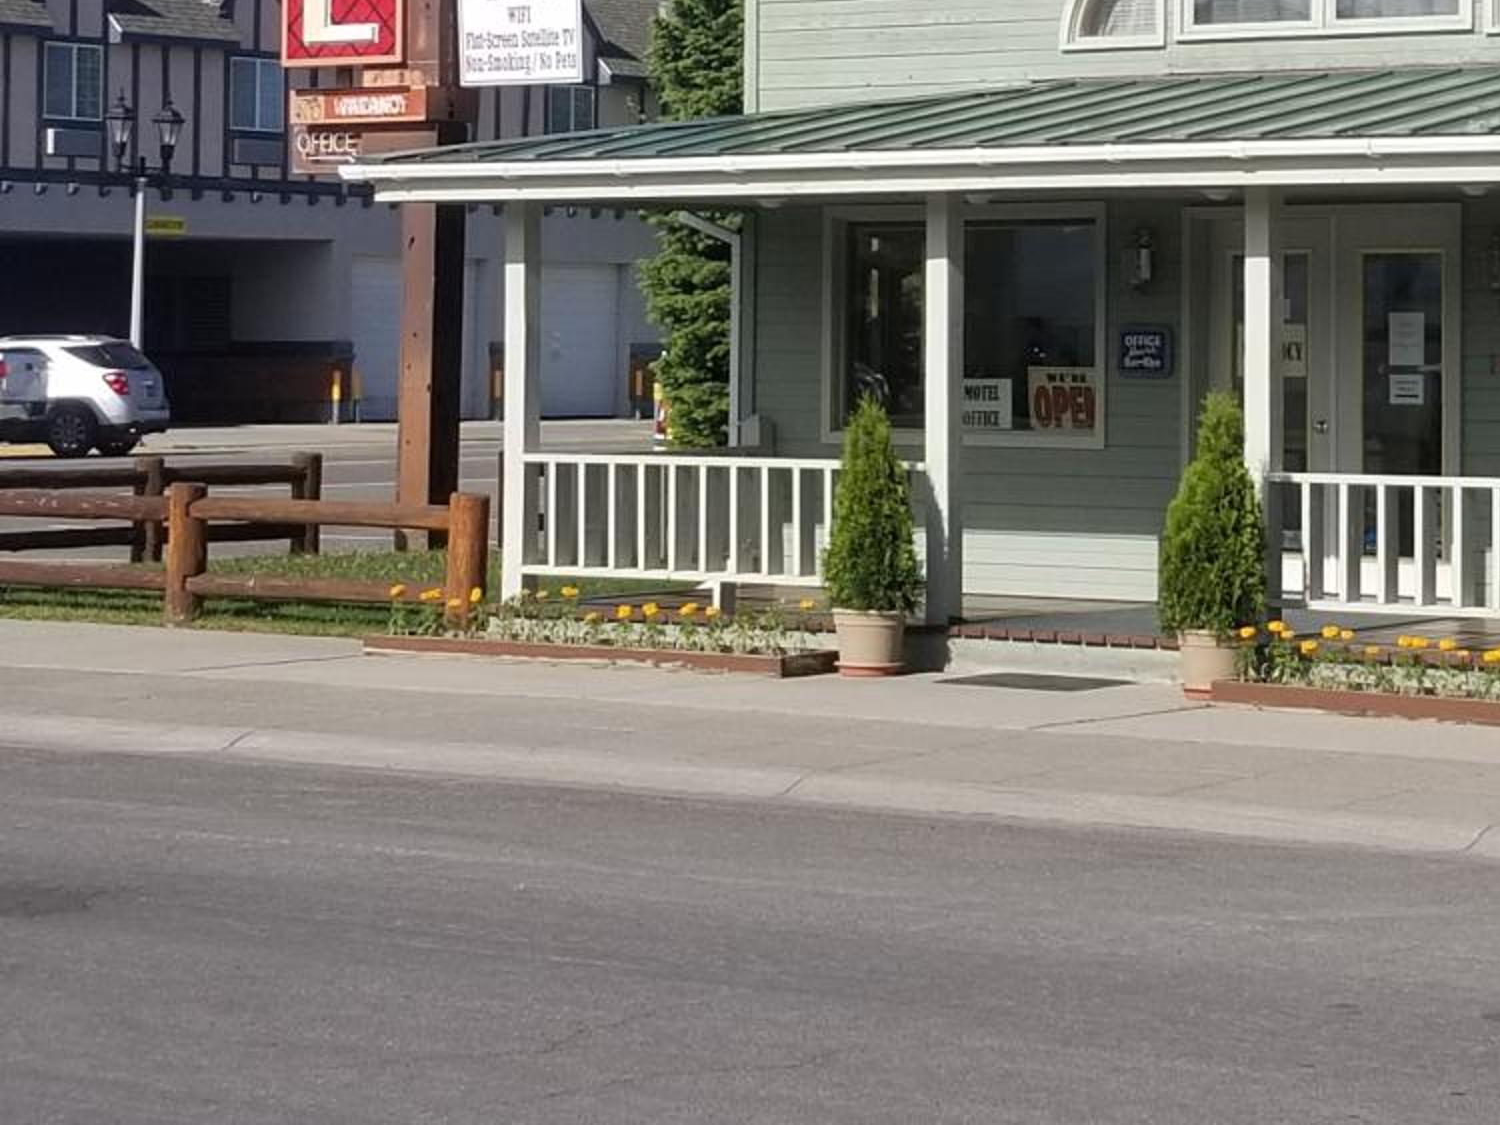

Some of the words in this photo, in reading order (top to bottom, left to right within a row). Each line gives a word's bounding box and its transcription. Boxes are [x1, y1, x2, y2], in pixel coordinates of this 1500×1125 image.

[563, 28, 575, 46] TV
[540, 51, 552, 70] No
[297, 131, 357, 154] OFFICE
[963, 385, 1001, 402] MOTEL
[962, 410, 1001, 427] OFFICE
